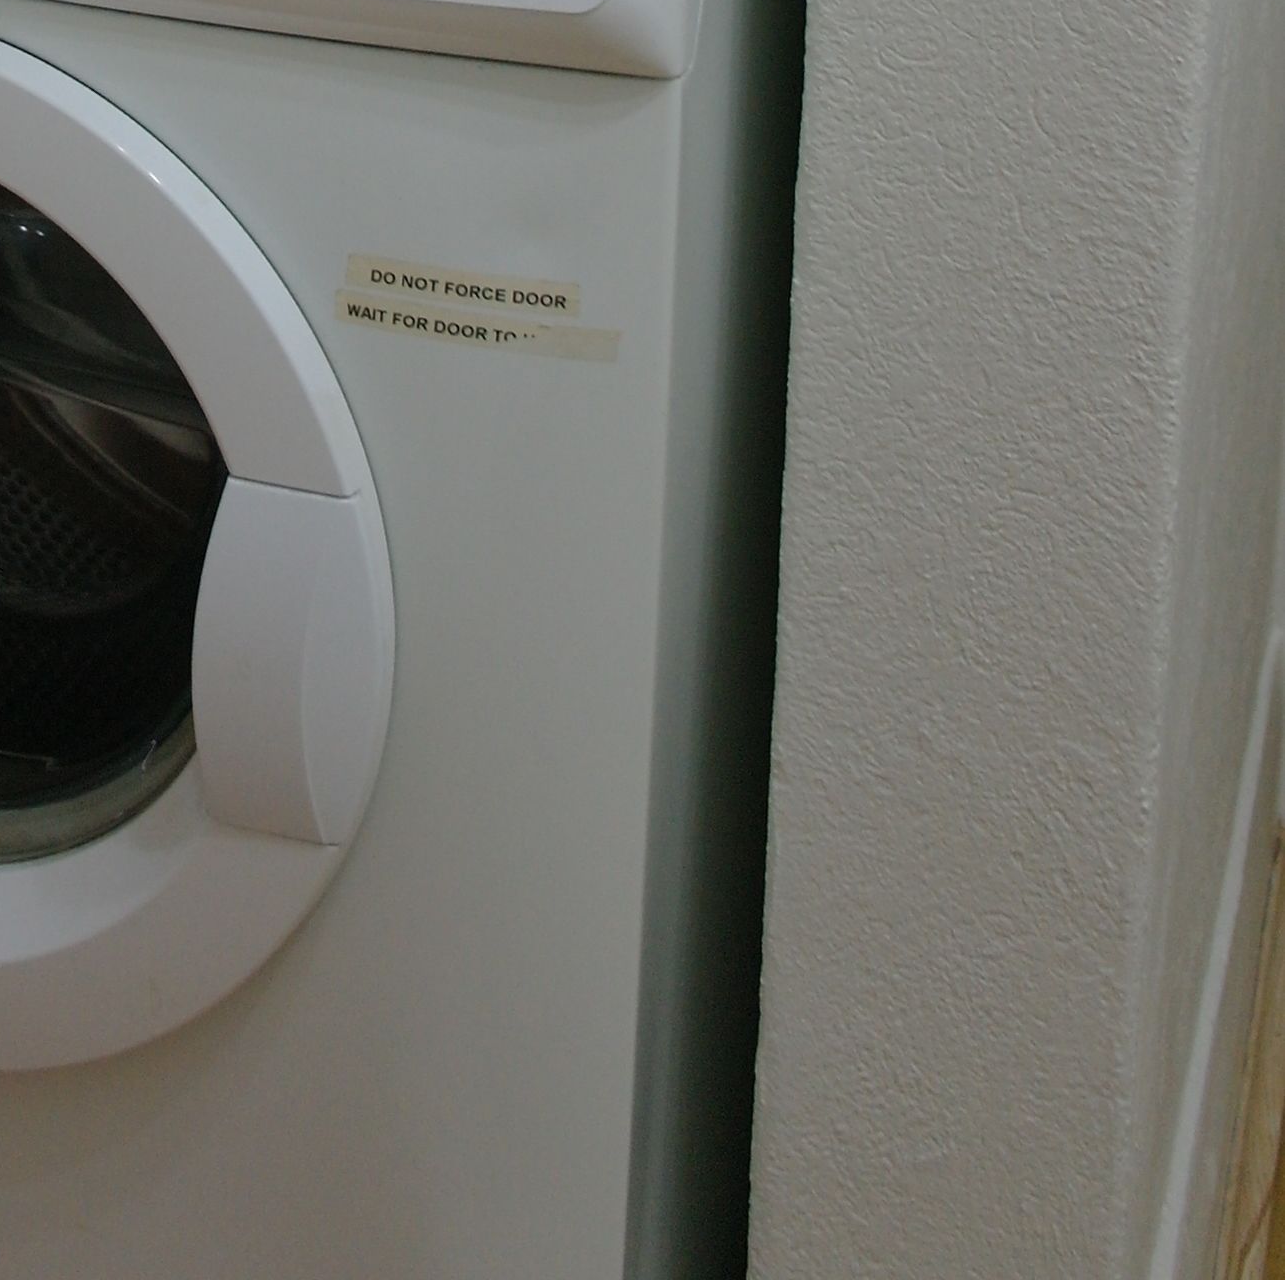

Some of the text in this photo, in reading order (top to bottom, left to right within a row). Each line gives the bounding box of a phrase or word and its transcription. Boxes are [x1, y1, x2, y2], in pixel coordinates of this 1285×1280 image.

[371, 269, 567, 309] DO NOT FORCE DOOR
[347, 303, 388, 323] WAIT
[392, 312, 428, 331] FOR
[434, 320, 487, 341] DOOR
